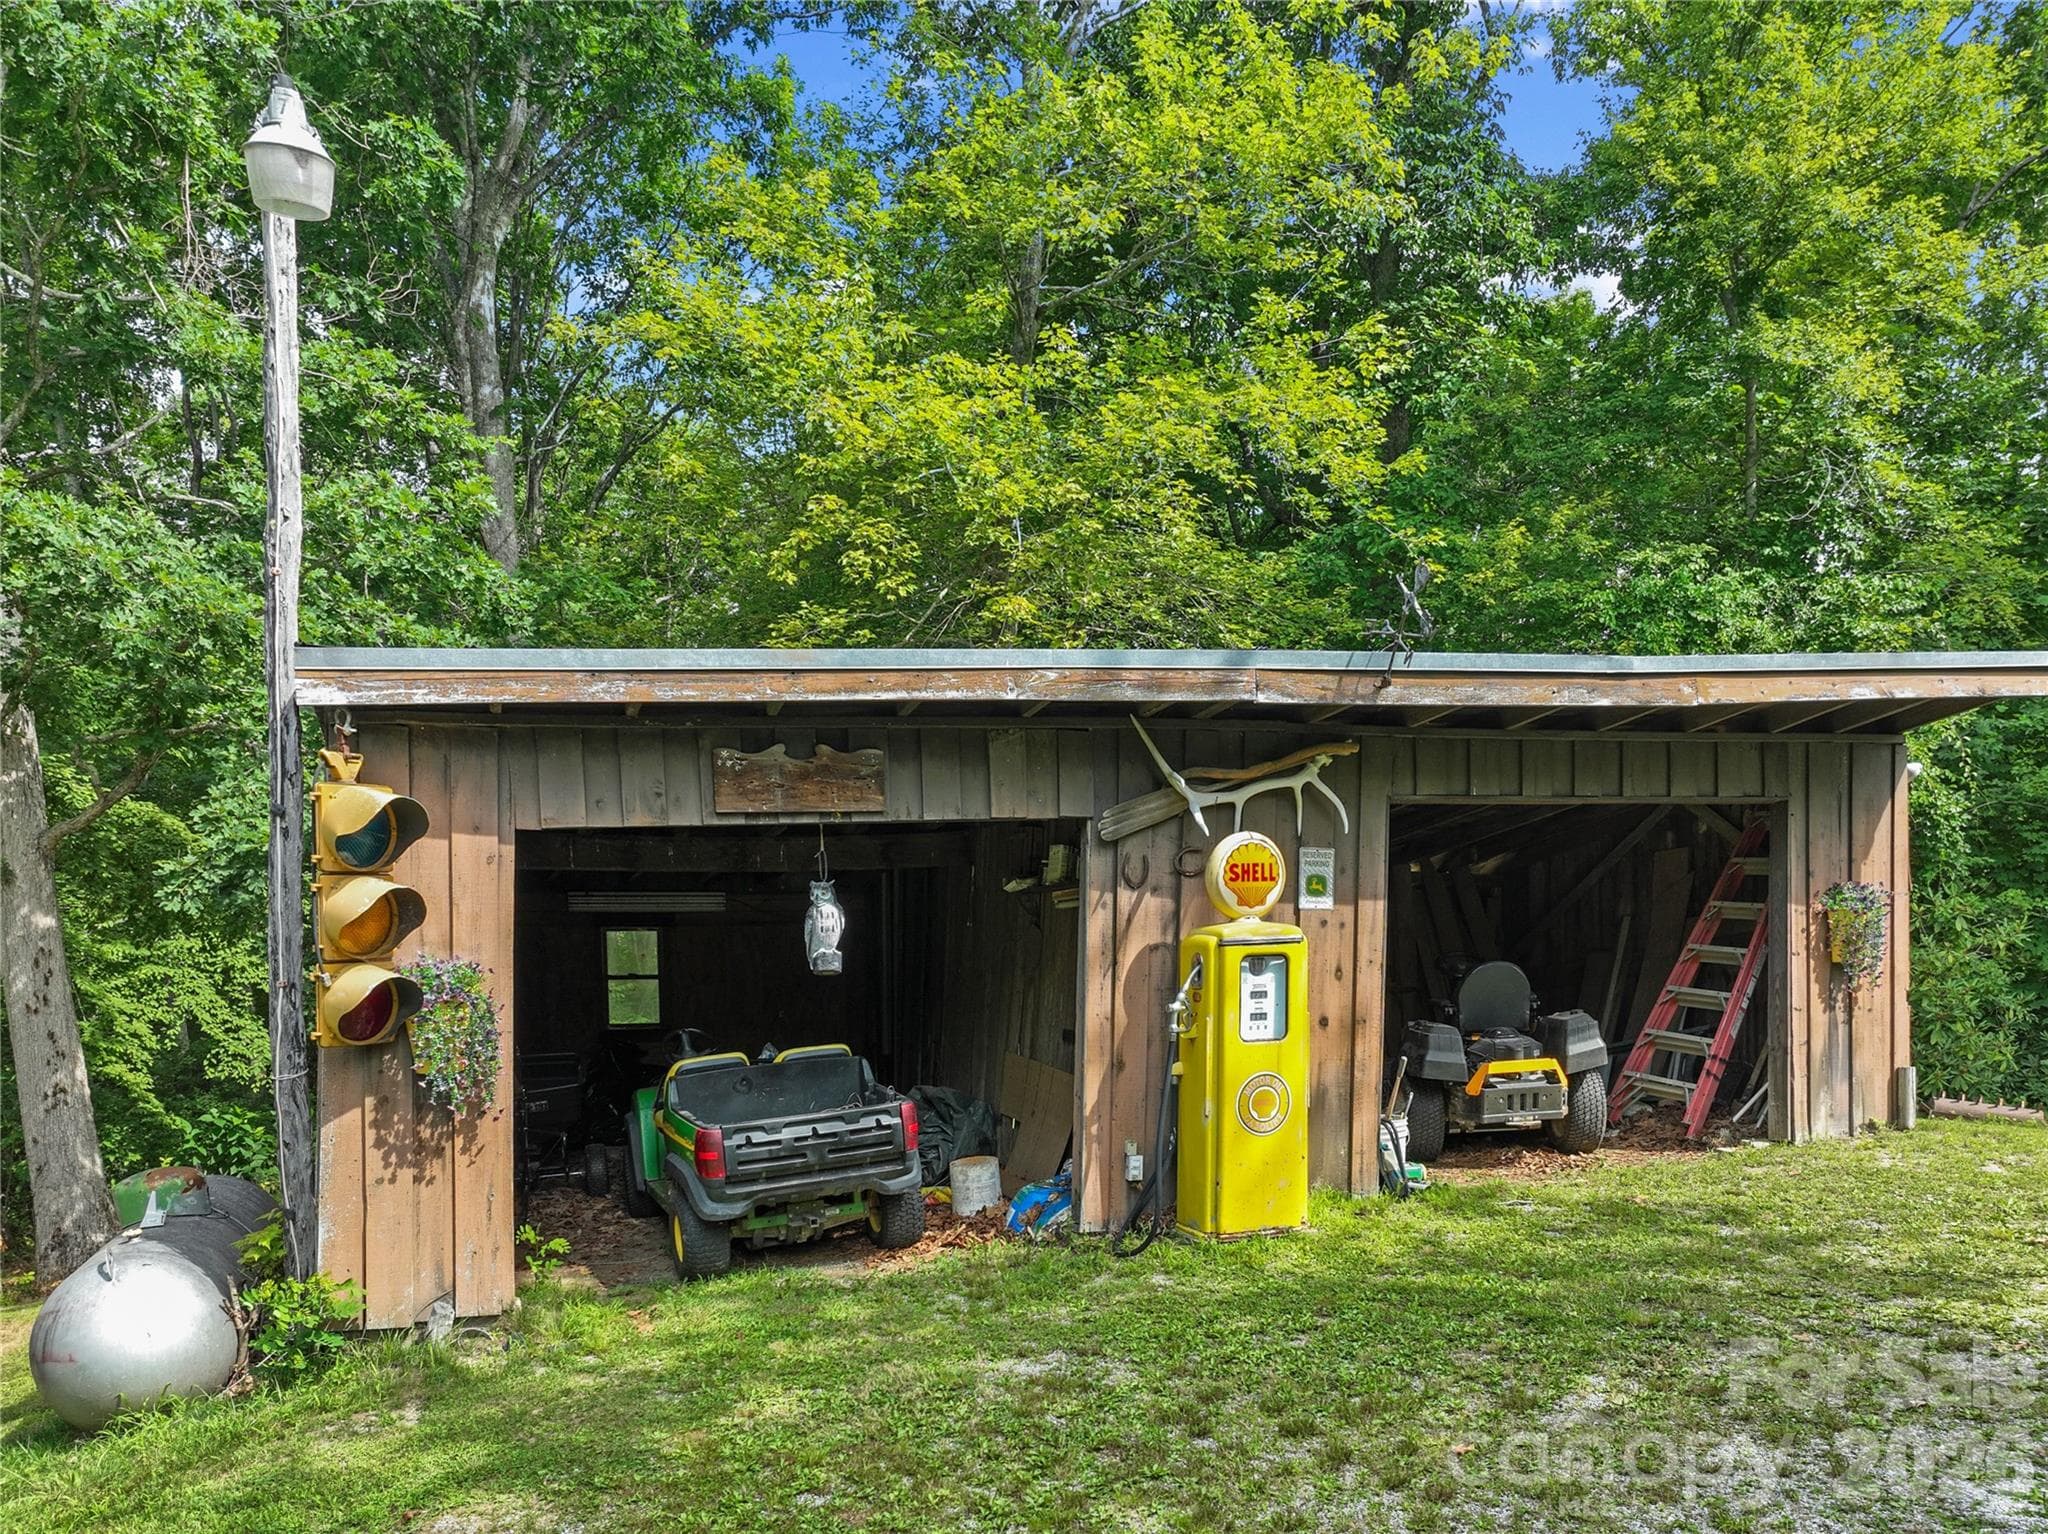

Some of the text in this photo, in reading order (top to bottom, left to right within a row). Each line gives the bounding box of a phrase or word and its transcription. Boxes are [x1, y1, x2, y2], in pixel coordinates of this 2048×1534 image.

[1302, 851, 1332, 860] RESERVED
[1304, 859, 1330, 868] PARKING
[1228, 862, 1276, 882] SHELL
